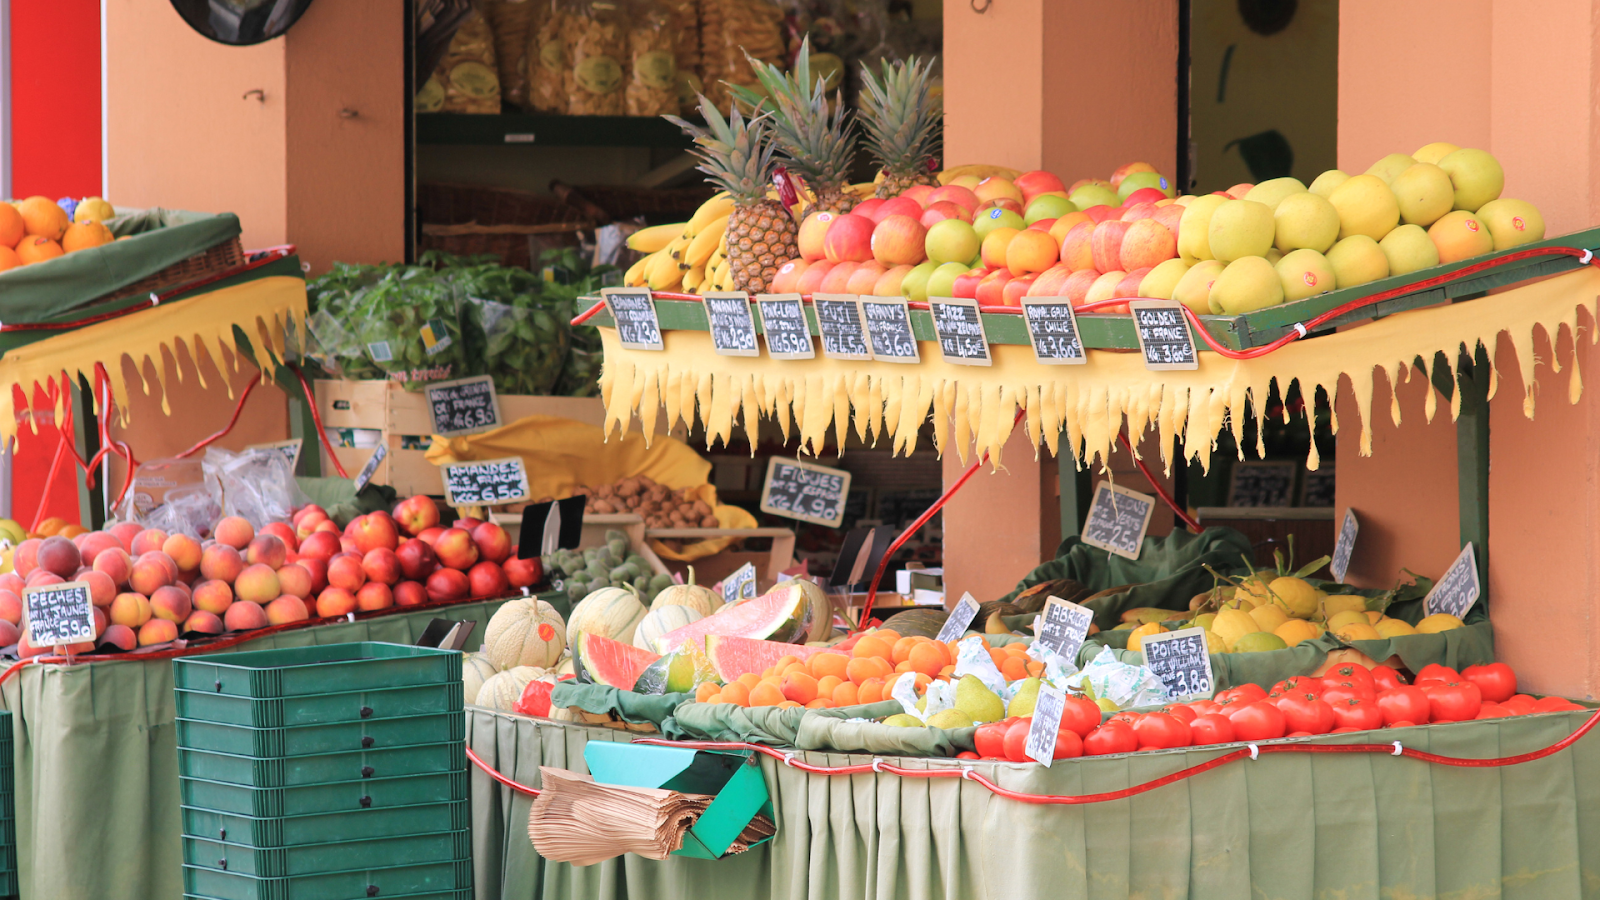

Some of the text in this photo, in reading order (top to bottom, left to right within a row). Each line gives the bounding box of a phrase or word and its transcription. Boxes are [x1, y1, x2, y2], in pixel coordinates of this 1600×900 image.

[611, 294, 649, 310] BANANES
[711, 299, 744, 314] ANANAS
[822, 300, 850, 324] FUJI
[939, 303, 966, 321] JAZZ
[1027, 305, 1070, 322] ROYAL GALA
[1140, 310, 1177, 326] GOLDEN
[450, 460, 520, 477] AMANDES
[780, 465, 841, 492] FIGUES
[453, 490, 479, 504] KG
[766, 493, 791, 511] KG
[1105, 490, 1148, 516] MELONS
[30, 587, 84, 608] PÊCHES
[29, 617, 60, 634] FRANCE
[36, 630, 57, 648] KG
[1151, 637, 1198, 660] POIRES
